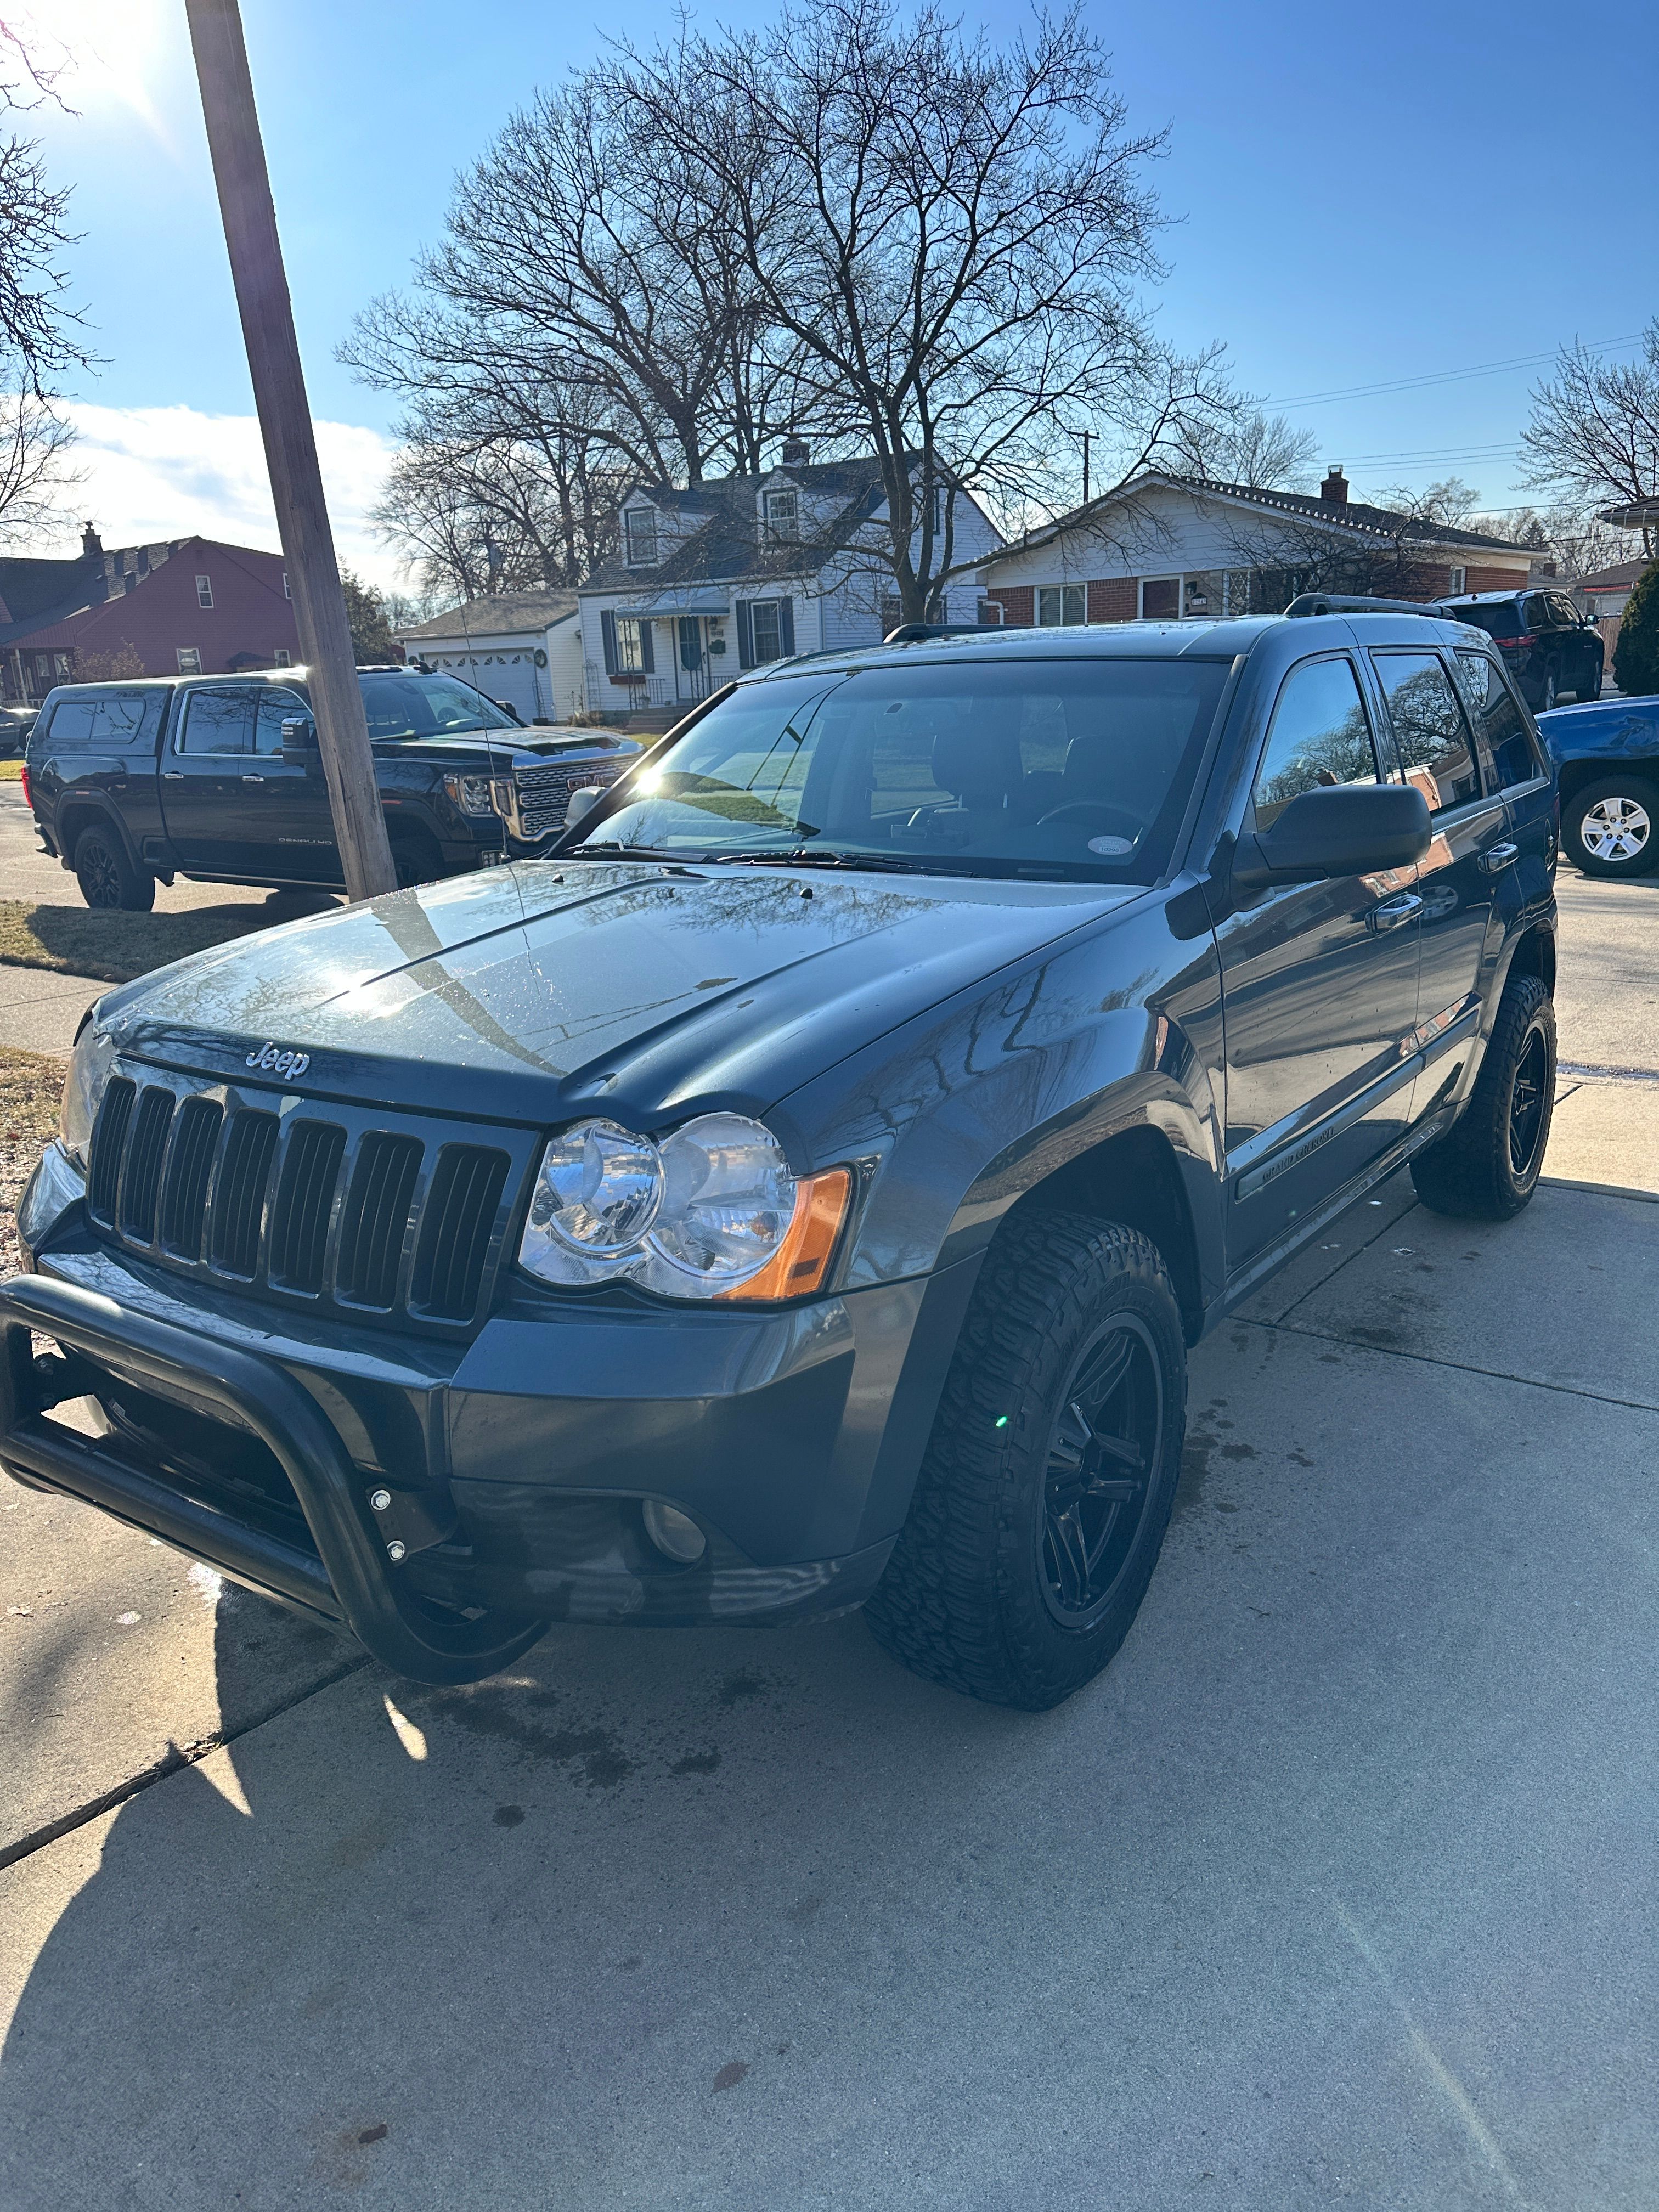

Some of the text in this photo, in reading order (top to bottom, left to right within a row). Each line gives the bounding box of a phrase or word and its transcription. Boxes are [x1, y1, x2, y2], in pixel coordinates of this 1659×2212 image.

[567, 772, 615, 790] GMC
[246, 1041, 311, 1081] Jeep
[1262, 1155, 1294, 1181] GRAND
